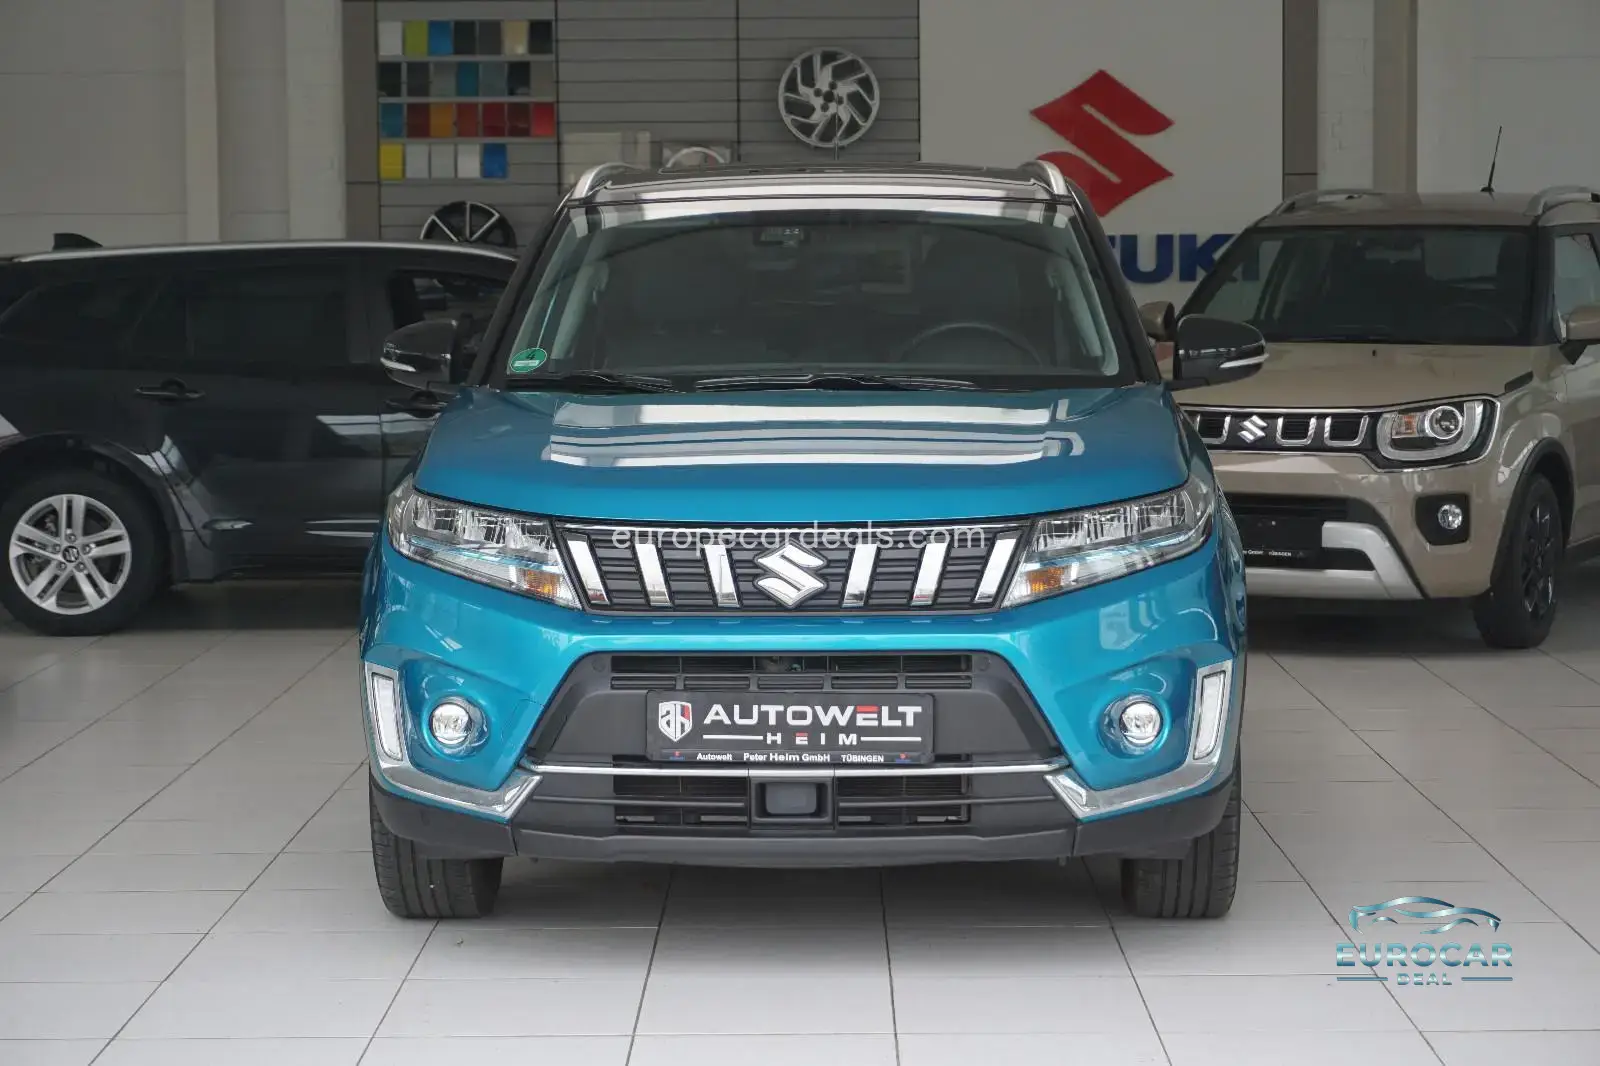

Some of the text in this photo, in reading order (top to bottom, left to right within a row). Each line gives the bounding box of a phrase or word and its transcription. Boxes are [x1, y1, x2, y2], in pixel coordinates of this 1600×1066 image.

[1106, 233, 1260, 284] UKI
[703, 703, 923, 728] AUTOWELT
[766, 732, 858, 746] HEIM
[696, 752, 733, 761] Autowelt
[743, 752, 768, 762] Peter
[769, 752, 800, 762] Heim
[801, 753, 831, 763] GmbH
[840, 754, 885, 763] TÜBINGEN
